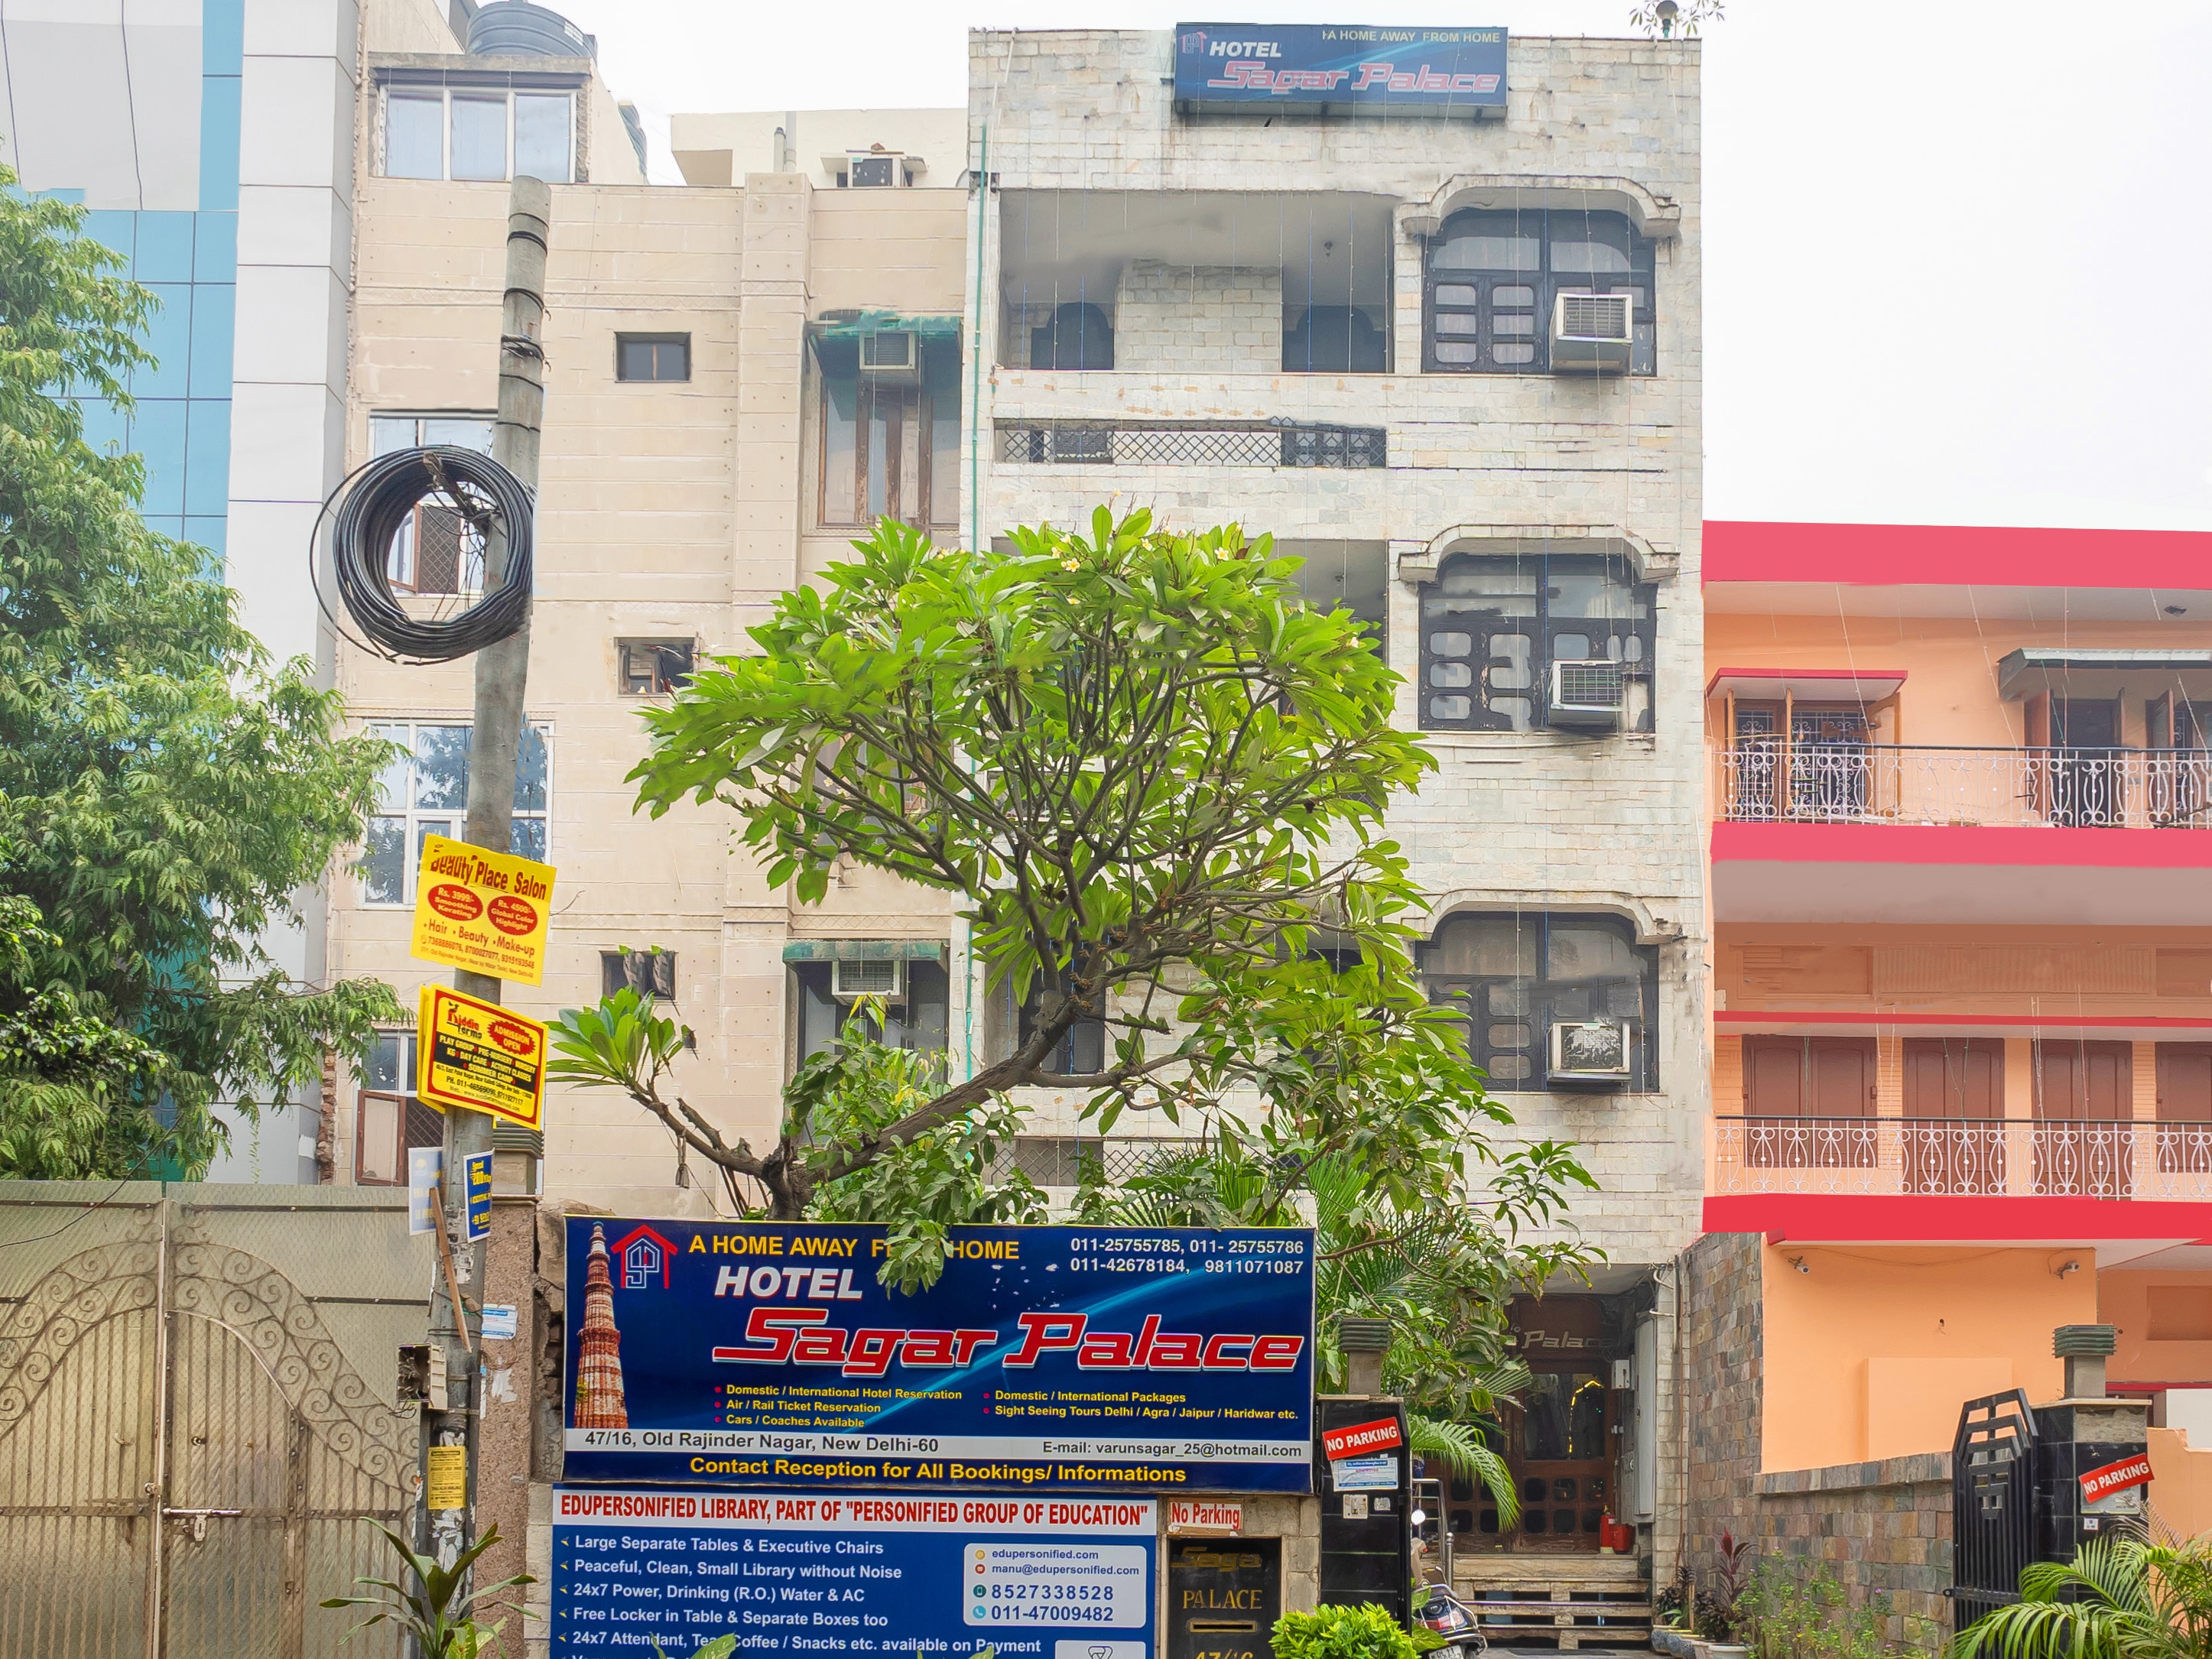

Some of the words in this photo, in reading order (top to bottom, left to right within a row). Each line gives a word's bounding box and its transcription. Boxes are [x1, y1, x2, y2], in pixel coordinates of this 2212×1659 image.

[1340, 30, 1376, 41] HOME
[1381, 31, 1415, 42] AWAY
[1423, 32, 1459, 43] FROM
[1463, 33, 1500, 43] HOME
[1210, 41, 1281, 57] HOTEL
[1207, 60, 1350, 95] Sagar
[1351, 63, 1500, 93] Palace
[475, 862, 508, 889] Place
[514, 872, 547, 900] Salon
[434, 897, 477, 913] Smoothing
[428, 918, 447, 934] Hair
[459, 927, 489, 947] Beauty
[497, 936, 534, 957] Make-up
[439, 1035, 454, 1045] PLAY
[494, 1025, 530, 1045] ADMISSION
[503, 1039, 520, 1050] OPEN
[460, 1052, 472, 1061] DAY
[689, 1235, 706, 1253] A
[713, 1236, 782, 1255] HOME
[790, 1238, 857, 1257] AWAY
[949, 1240, 1019, 1259] HOME
[1071, 1238, 1184, 1255] 011-25755785,
[1190, 1240, 1223, 1253] 011-
[1229, 1241, 1303, 1255] 25755786
[1071, 1258, 1190, 1275] 011-42678184,
[1205, 1260, 1303, 1274] 9811071087
[715, 1265, 862, 1299] HOTEL
[713, 1307, 998, 1378] Sagar
[1002, 1312, 1304, 1372] Palace
[727, 1385, 779, 1395] Domestic
[781, 1386, 786, 1396] /
[789, 1387, 859, 1397] International
[862, 1388, 892, 1398] Hotel
[895, 1388, 962, 1400] Reservation
[996, 1391, 1048, 1401] Domestic
[1051, 1391, 1055, 1401] /
[1058, 1391, 1129, 1402] International
[1132, 1392, 1186, 1404] Packages
[727, 1400, 743, 1410] Air
[745, 1401, 750, 1411] /
[753, 1401, 774, 1411] Rail
[778, 1401, 811, 1411] Ticket
[814, 1402, 881, 1413] Reservation
[995, 1405, 1025, 1418] Sight
[1028, 1406, 1067, 1418] Seeing
[1070, 1407, 1101, 1417] Tours
[1104, 1407, 1133, 1417] Delhi
[1136, 1407, 1140, 1417] /
[1143, 1408, 1170, 1420] Agra
[1172, 1408, 1177, 1418] /
[1179, 1408, 1215, 1420] Jaipur
[1218, 1409, 1222, 1419] /
[1225, 1409, 1273, 1419] Haridwar
[1278, 1410, 1298, 1419] etc.
[726, 1415, 752, 1425] Cars
[755, 1416, 760, 1426] /
[762, 1416, 810, 1427] Coaches
[814, 1417, 865, 1427] Available
[585, 1431, 636, 1448] 47/16,
[643, 1432, 673, 1446] Old
[680, 1433, 754, 1450] Rajinder
[760, 1435, 817, 1453] Nagar,
[823, 1437, 860, 1451] New
[866, 1437, 938, 1453] Delhi-60
[1327, 1438, 1343, 1452] NO
[1346, 1426, 1397, 1447] PARKING
[1044, 1441, 1091, 1454] E-mail:
[1096, 1443, 1301, 1458] varunsagar_25@hotmail.com
[690, 1457, 768, 1475] Contact
[775, 1459, 876, 1481] Reception
[882, 1462, 911, 1478] for
[917, 1463, 944, 1479] All
[950, 1463, 1052, 1484] Bookings/
[1059, 1466, 1186, 1482] Informations
[2084, 1479, 2097, 1495] NO
[2098, 1463, 2149, 1488] PARKING
[561, 1495, 696, 1518] EDUPERSONIFIED
[701, 1498, 771, 1524] LIBRARY,
[777, 1500, 816, 1521] PART
[820, 1502, 842, 1521] OF
[846, 1502, 958, 1523] "PERSONIFIED
[963, 1502, 1018, 1524] GROUP
[1024, 1503, 1044, 1524] OF
[1050, 1505, 1148, 1526] EDUCATION"
[1171, 1502, 1188, 1524] No
[1192, 1503, 1240, 1530] Parking
[575, 1536, 616, 1550] Large
[622, 1537, 686, 1552] Separate
[692, 1538, 738, 1552] Tables
[743, 1539, 753, 1552] &
[759, 1540, 831, 1554] Executive
[836, 1541, 883, 1554] Chairs
[992, 1549, 1099, 1561] edupersonified.com
[575, 1560, 642, 1576] Peaceful,
[647, 1561, 692, 1577] Clean,
[697, 1563, 738, 1576] Small
[743, 1563, 795, 1580] Library
[800, 1565, 855, 1578] without
[860, 1566, 901, 1579] Noise
[992, 1563, 1139, 1576] manu@edupersonified.com
[574, 1584, 608, 1596] 24x7
[613, 1585, 662, 1601] Power,
[667, 1586, 729, 1602] Drinking
[734, 1587, 776, 1603] (R.O.)
[781, 1588, 823, 1602] Water
[827, 1589, 838, 1602] &
[843, 1589, 865, 1602] AC
[992, 1585, 1114, 1601] 8527338528
[1183, 1589, 1262, 1609] PALACE
[574, 1608, 606, 1621] Free
[611, 1609, 661, 1622] Locker
[666, 1610, 678, 1622] in
[684, 1610, 722, 1624] Table
[728, 1612, 738, 1624] &
[743, 1612, 808, 1628] Separate
[814, 1613, 859, 1627] Boxes
[863, 1614, 888, 1627] too
[992, 1606, 1114, 1622] 011-47009482
[573, 1631, 606, 1644] 24x7
[611, 1632, 687, 1648] Attendant,
[735, 1635, 778, 1648] Coffee
[783, 1636, 788, 1649] /
[792, 1636, 846, 1650] Snacks
[851, 1637, 877, 1650] etc.
[882, 1638, 947, 1651] available
[953, 1641, 971, 1651] on
[976, 1639, 1041, 1654] Payment
